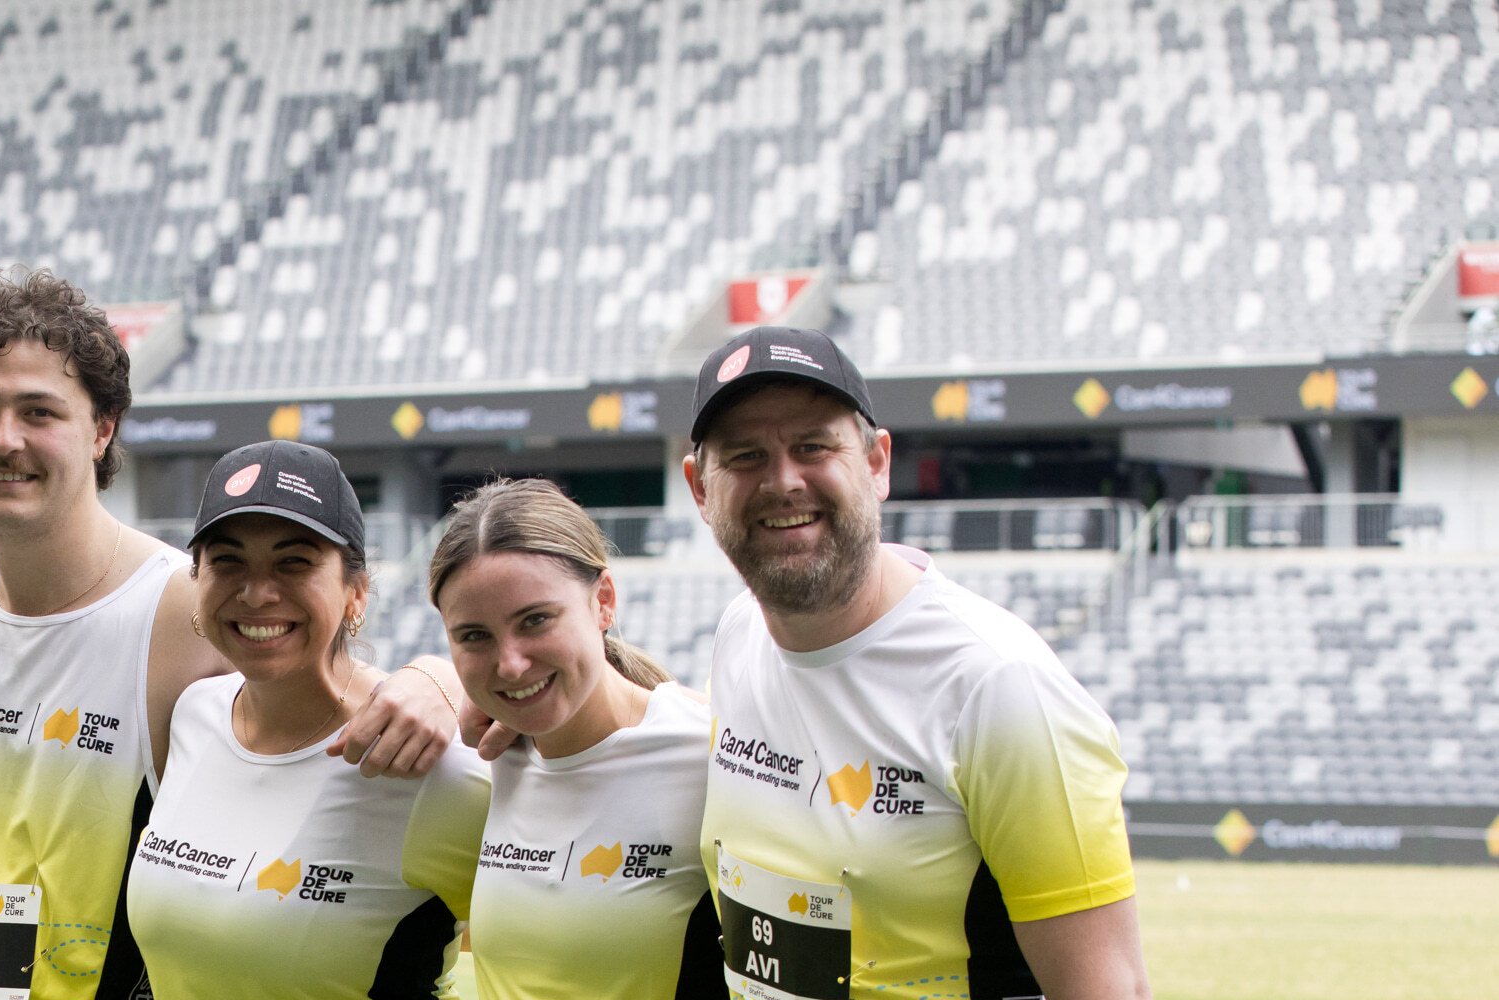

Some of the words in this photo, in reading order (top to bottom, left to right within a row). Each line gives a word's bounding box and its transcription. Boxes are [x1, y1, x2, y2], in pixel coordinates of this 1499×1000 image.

[276, 482, 293, 492] Event
[277, 477, 292, 486] Tech
[84, 712, 120, 731] TOUR
[79, 724, 99, 738] DE
[76, 736, 114, 755] CURE
[720, 727, 804, 777] Can4Cancer
[715, 752, 738, 773] Changing
[738, 763, 755, 780] lives,
[756, 772, 780, 787] ending
[780, 778, 800, 791] cancer
[878, 766, 925, 783] TOUR
[875, 783, 899, 798] DE
[873, 799, 925, 815] CURE
[144, 831, 236, 871] Can4Cancer
[628, 844, 672, 857] TOUR
[160, 855, 176, 869] lives,
[177, 861, 201, 875] ending
[202, 868, 228, 881] cancer
[505, 862, 527, 872] ending
[624, 856, 648, 867] DE
[308, 864, 354, 884] TOUR
[622, 868, 667, 879] CURE
[302, 876, 328, 890] DE
[299, 888, 346, 903] CURE
[810, 895, 833, 905] TOUR
[810, 911, 833, 920] CURE
[751, 915, 773, 946] 69
[745, 950, 780, 984] AV1
[749, 987, 762, 998] Staff
